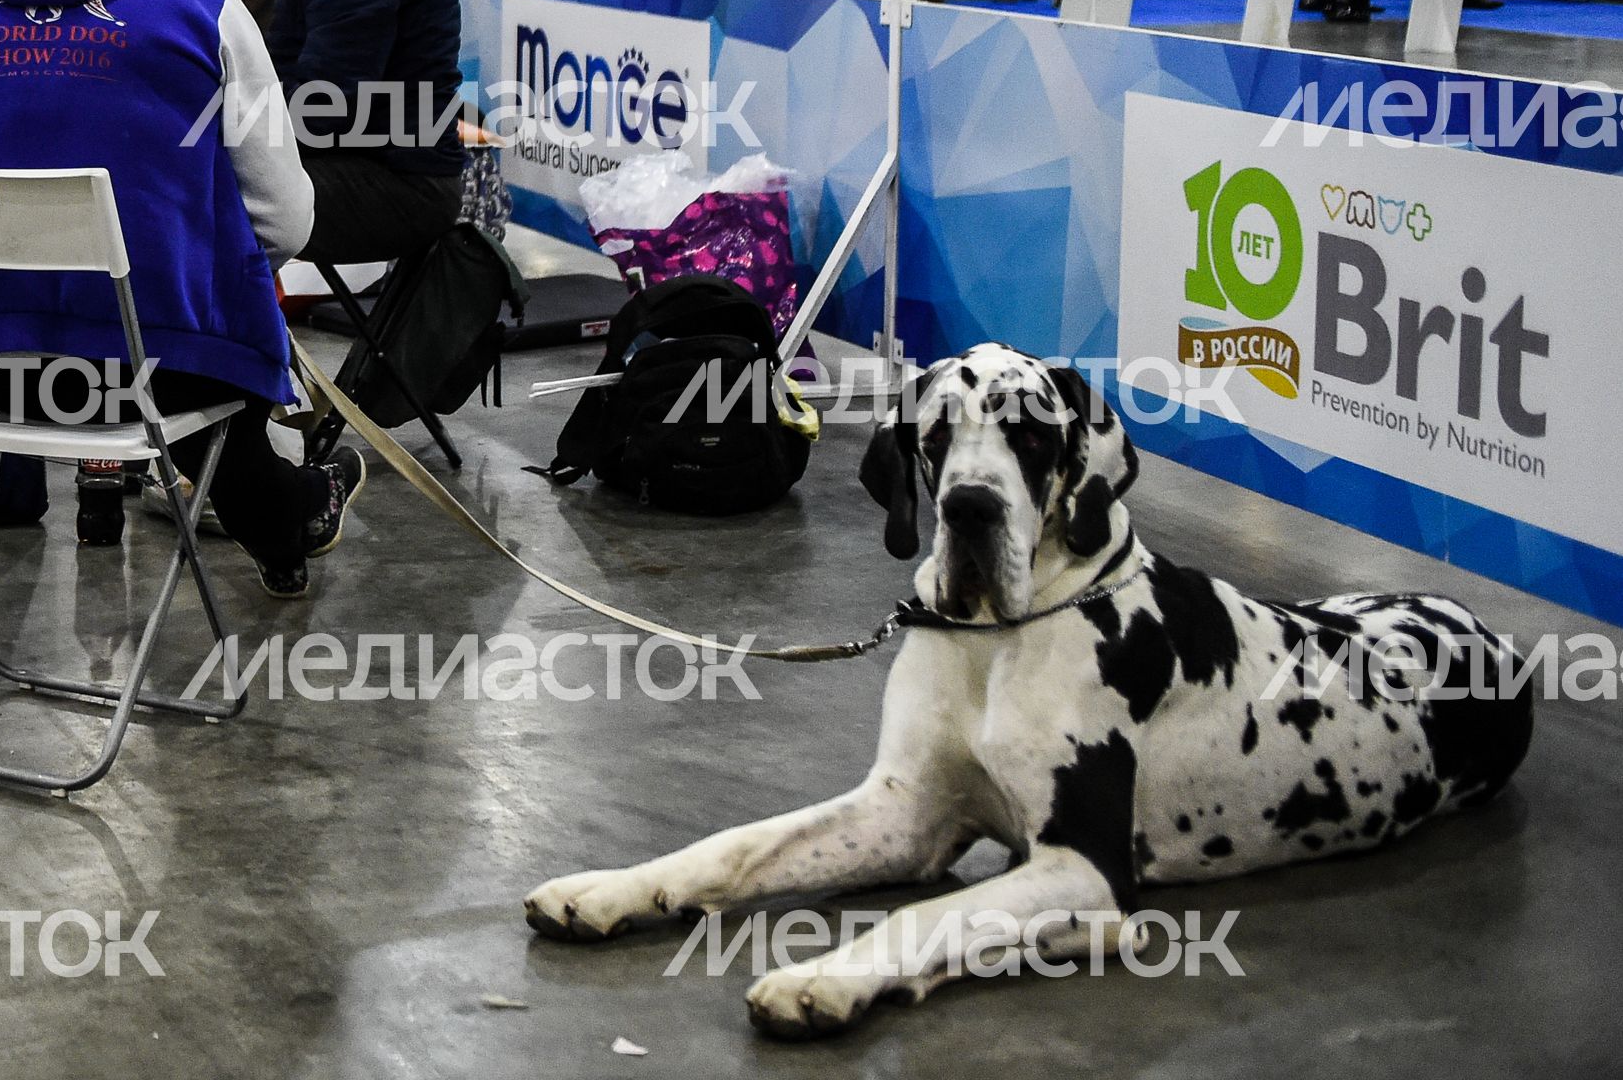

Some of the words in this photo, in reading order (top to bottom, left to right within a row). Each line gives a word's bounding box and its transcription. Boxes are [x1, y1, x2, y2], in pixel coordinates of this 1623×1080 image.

[68, 25, 128, 49] DOG
[7, 70, 80, 78] MOSCOW
[59, 47, 112, 69] 2016
[1182, 159, 1304, 321] 10
[1236, 229, 1276, 261] ЛЕТ
[1192, 337, 1206, 364] В
[1211, 333, 1293, 371] РОССИИ
[1312, 230, 1550, 439] Brit
[1311, 379, 1410, 435] Prevention
[1416, 418, 1441, 451] by
[1446, 421, 1547, 478] Nutrition
